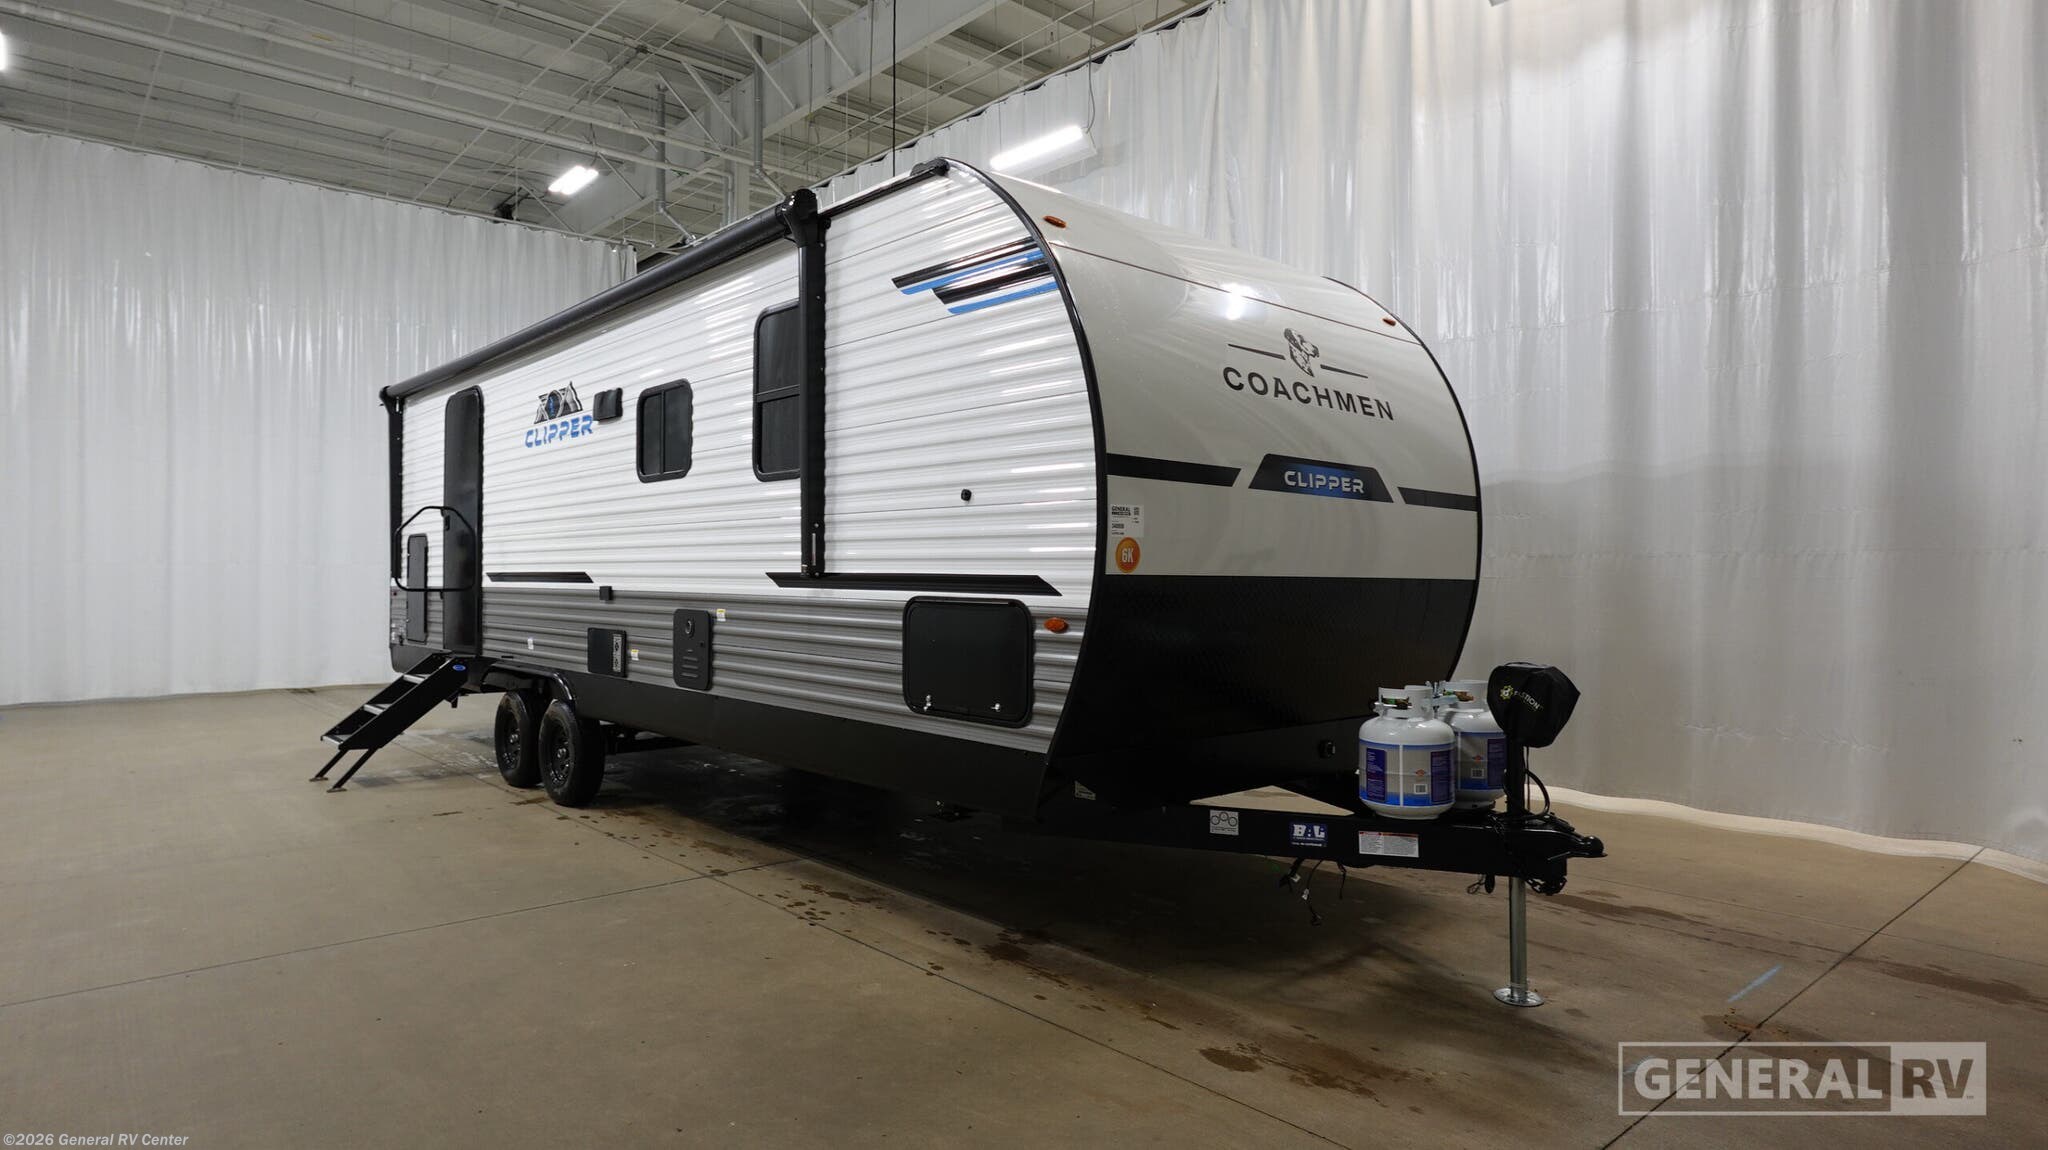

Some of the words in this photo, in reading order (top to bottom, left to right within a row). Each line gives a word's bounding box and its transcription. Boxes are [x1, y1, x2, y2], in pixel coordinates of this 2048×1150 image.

[1223, 366, 1395, 421] COACHMEN
[524, 414, 594, 449] CLIPPER
[1284, 469, 1366, 495] CLIPPER
[1121, 547, 1135, 564] 6K
